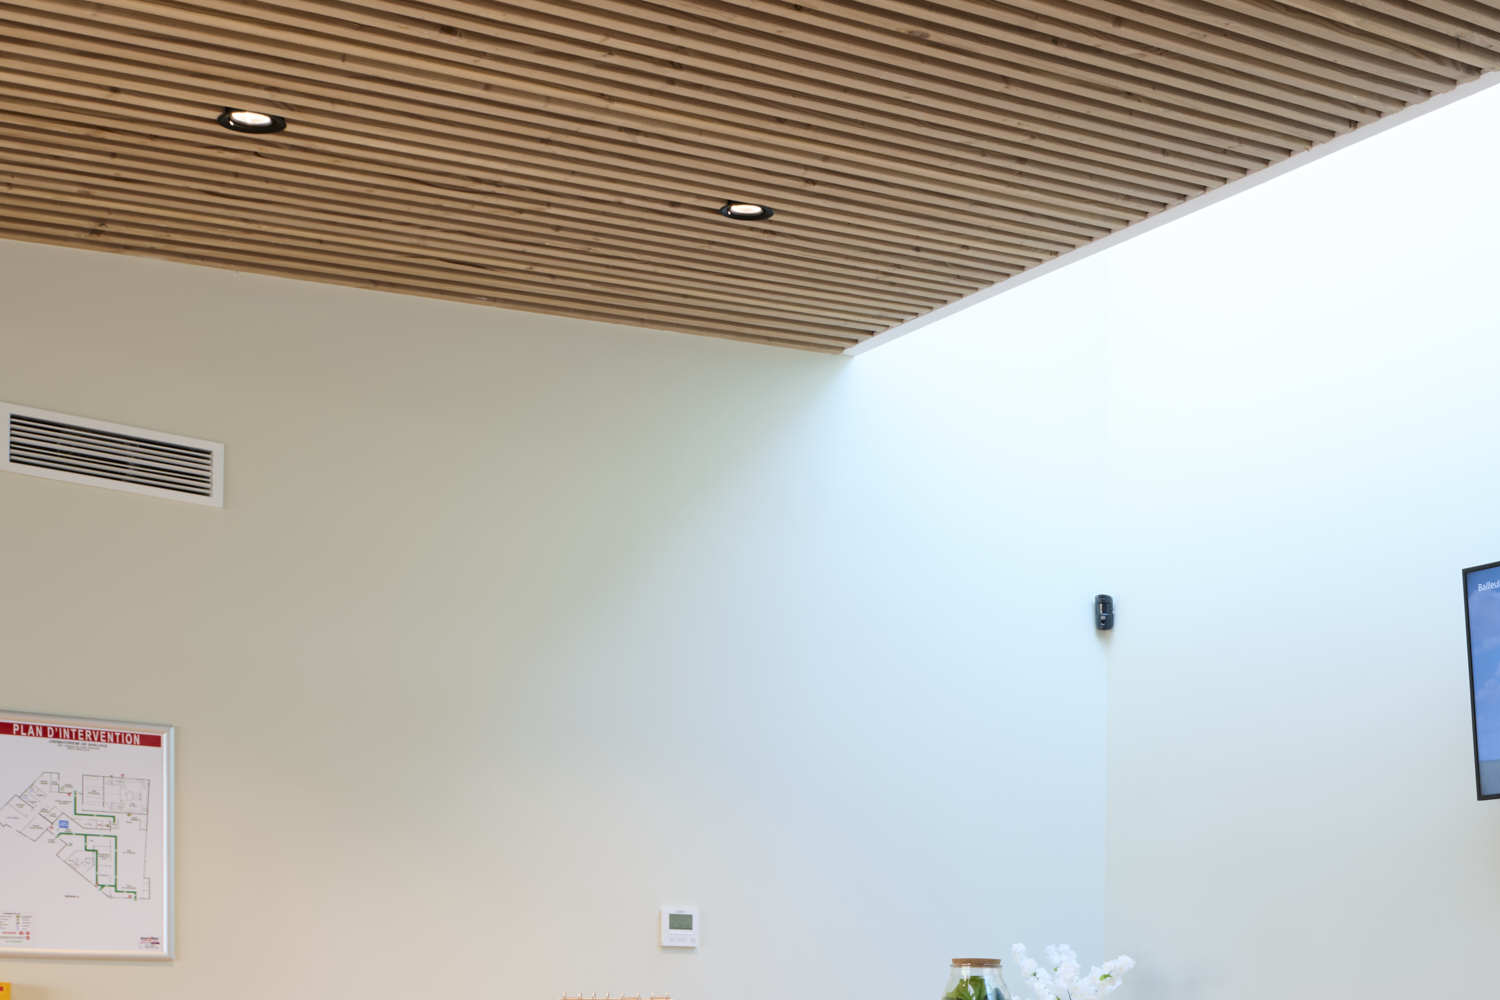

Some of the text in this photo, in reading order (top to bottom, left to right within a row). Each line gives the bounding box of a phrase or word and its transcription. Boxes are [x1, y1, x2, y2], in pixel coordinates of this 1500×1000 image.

[1477, 579, 1500, 592] Bailleul
[13, 723, 140, 745] PLAN D'INTERVENTION
